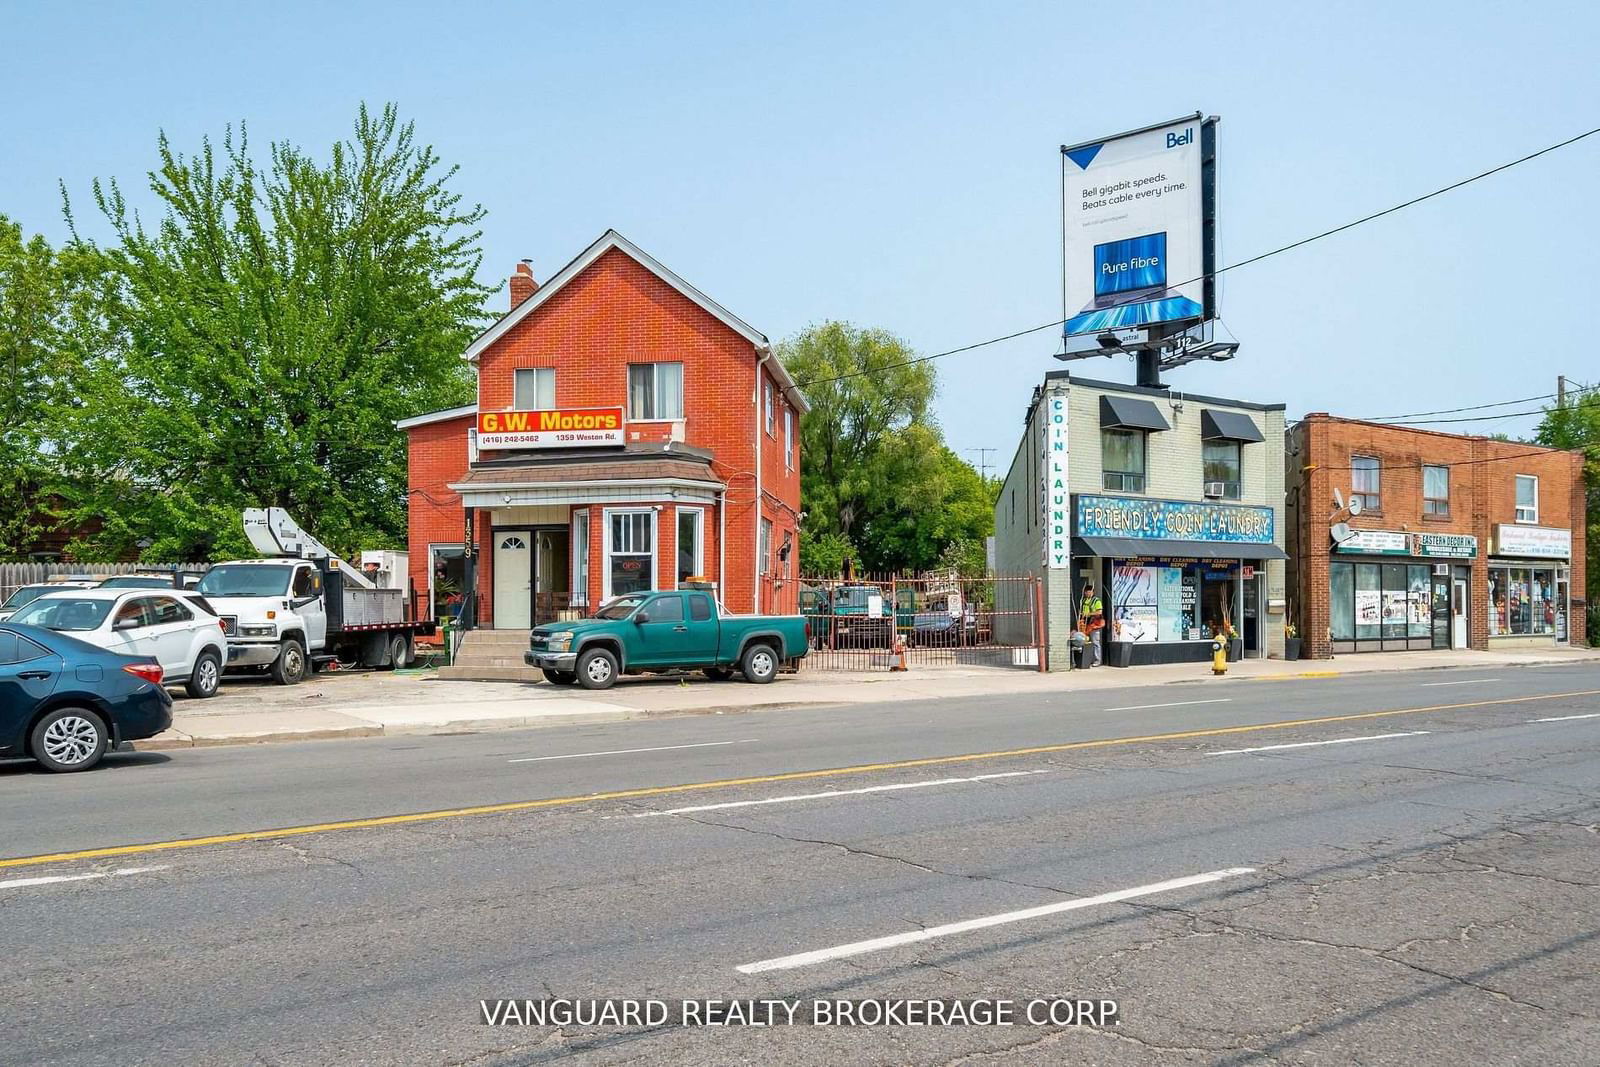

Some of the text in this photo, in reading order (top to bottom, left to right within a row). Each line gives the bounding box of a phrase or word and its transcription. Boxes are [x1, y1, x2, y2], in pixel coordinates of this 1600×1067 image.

[1166, 128, 1193, 149] Bell
[1082, 173, 1168, 198] Bell gigabit speeds.
[1082, 182, 1188, 211] Beats cable every time.
[1102, 256, 1159, 275] Pure fibre
[1122, 333, 1140, 342] astral
[1176, 337, 1192, 348] 112
[482, 411, 617, 432] G.W. Motors
[1053, 400, 1064, 451] COIN
[482, 435, 503, 445] (416)
[504, 435, 540, 443] 242-5462
[576, 433, 603, 441] Weston
[605, 433, 617, 441] Rd.
[1053, 462, 1064, 564] LAUNDRY
[1084, 507, 1269, 536] FRIENDLY COIN LAUNDRY
[1422, 535, 1446, 546] EASTERN
